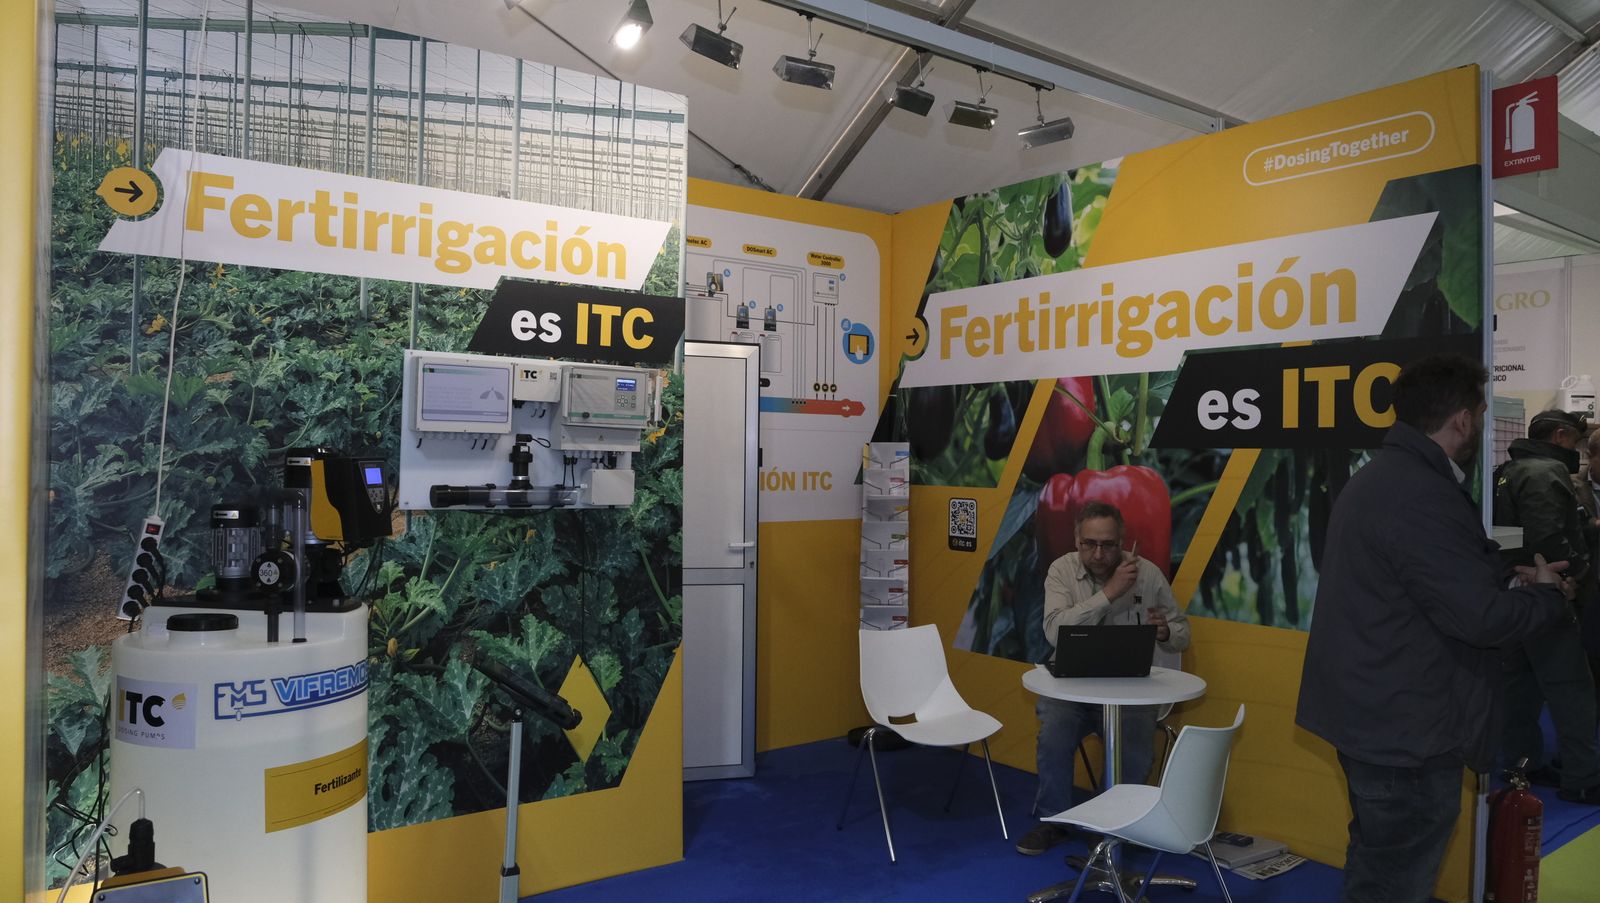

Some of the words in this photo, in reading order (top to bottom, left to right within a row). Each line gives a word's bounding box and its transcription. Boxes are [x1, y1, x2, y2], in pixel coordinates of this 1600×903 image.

[1263, 128, 1410, 173] #DosingTogether
[1504, 154, 1541, 167] EXTINTOR
[186, 171, 626, 280] Fertirrigación
[511, 310, 561, 343] es
[576, 301, 654, 350] ITC
[940, 256, 1357, 360] Fertirrigación
[520, 368, 538, 379] ITC
[1197, 389, 1261, 430] es
[1282, 361, 1402, 429] ITC
[802, 471, 833, 491] ITC
[260, 569, 273, 577] 360
[118, 687, 166, 727] ITC
[314, 767, 362, 796] Fertilizante
